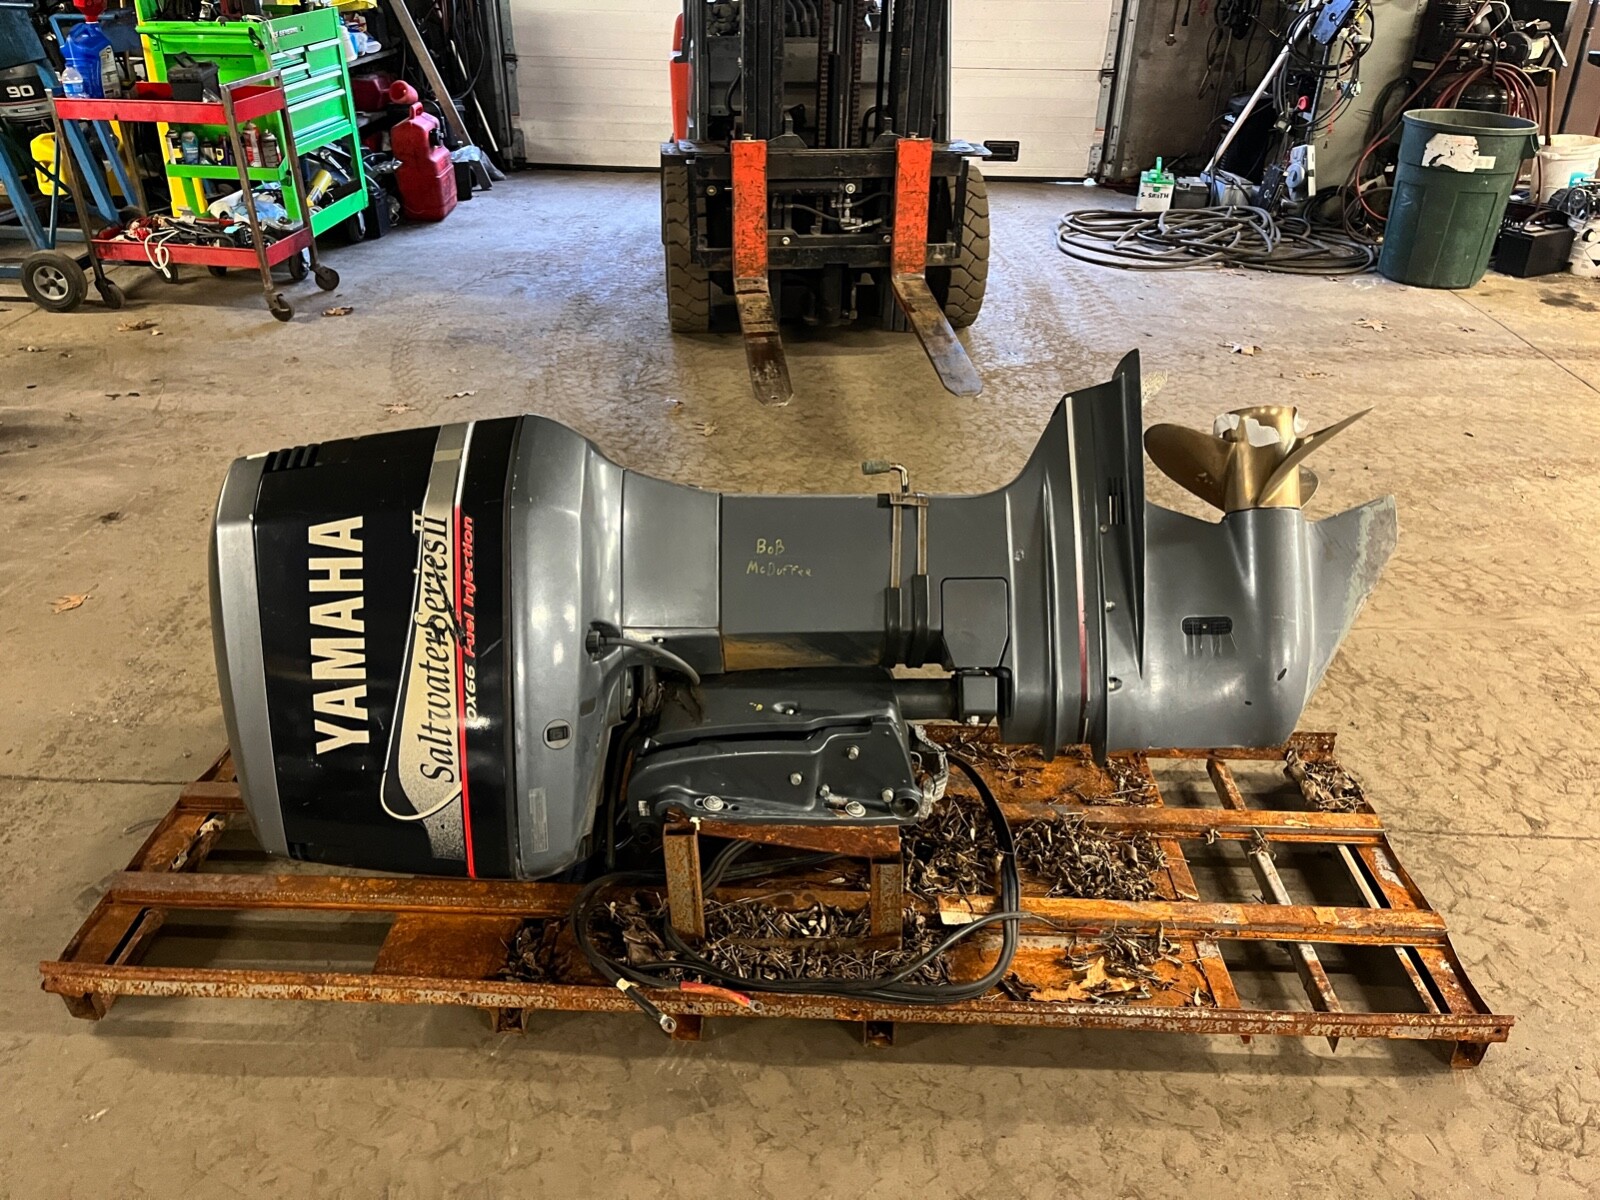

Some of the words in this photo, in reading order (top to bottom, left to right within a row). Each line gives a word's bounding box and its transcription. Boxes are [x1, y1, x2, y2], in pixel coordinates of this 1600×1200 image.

[6, 85, 35, 98] 90
[462, 515, 477, 608] Injection
[308, 515, 370, 755] YAMAHA
[464, 611, 476, 658] Fuel
[416, 630, 455, 783] Saltwater
[464, 662, 477, 722] OX66
